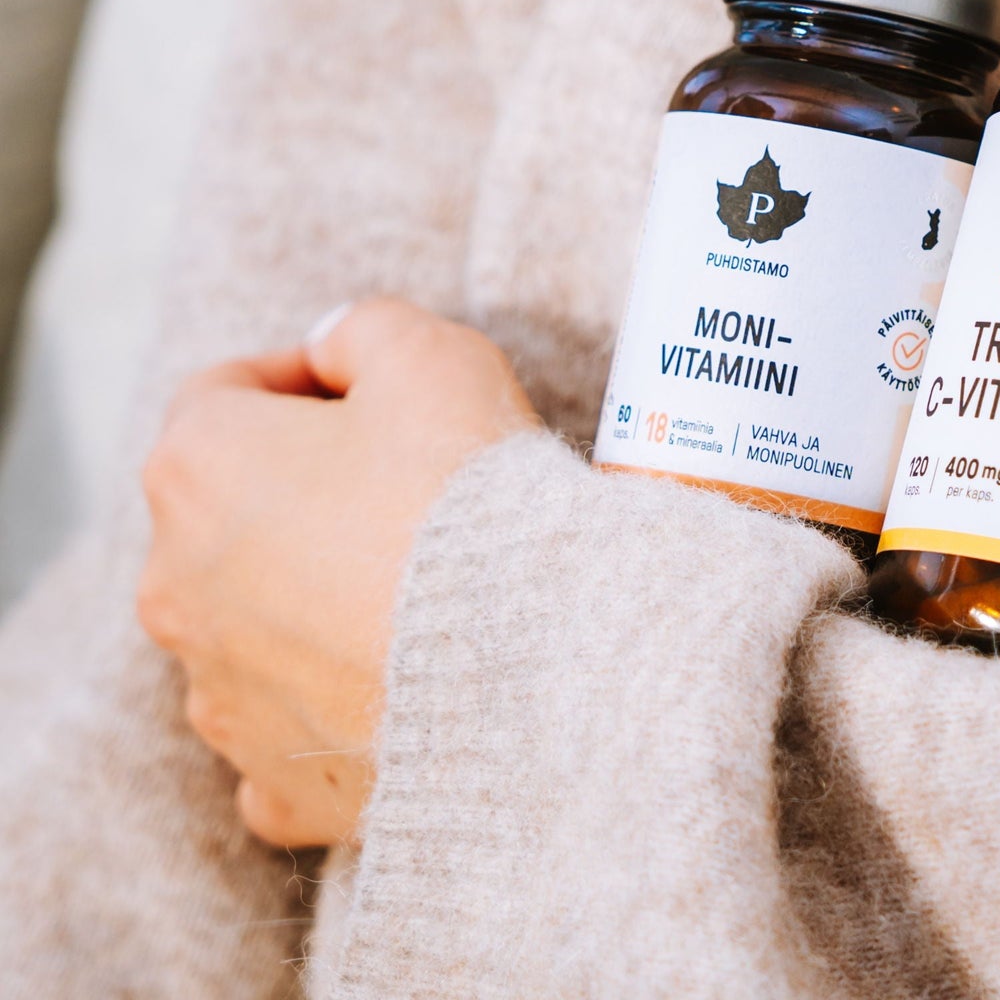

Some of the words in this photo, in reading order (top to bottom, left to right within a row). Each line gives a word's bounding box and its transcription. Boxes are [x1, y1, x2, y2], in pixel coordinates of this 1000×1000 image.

[746, 192, 775, 225] P
[706, 252, 789, 279] PUHDISTAMO
[694, 306, 792, 349] MONI-
[878, 309, 934, 339] PÄIVITTÄISE
[661, 343, 799, 397] VITAMIINI
[877, 363, 921, 391] KÄYTTÖÖ
[618, 405, 631, 423] 60
[646, 411, 668, 444] 18
[672, 418, 714, 434] vitamiinia
[676, 436, 722, 453] mineraalia
[751, 425, 797, 447] VAHVA
[802, 433, 820, 452] JA
[747, 445, 853, 480] MONIPUOLINEN
[908, 455, 929, 478] 120
[944, 456, 979, 480] 400
[946, 484, 963, 500] per
[965, 485, 994, 504] kaps.
